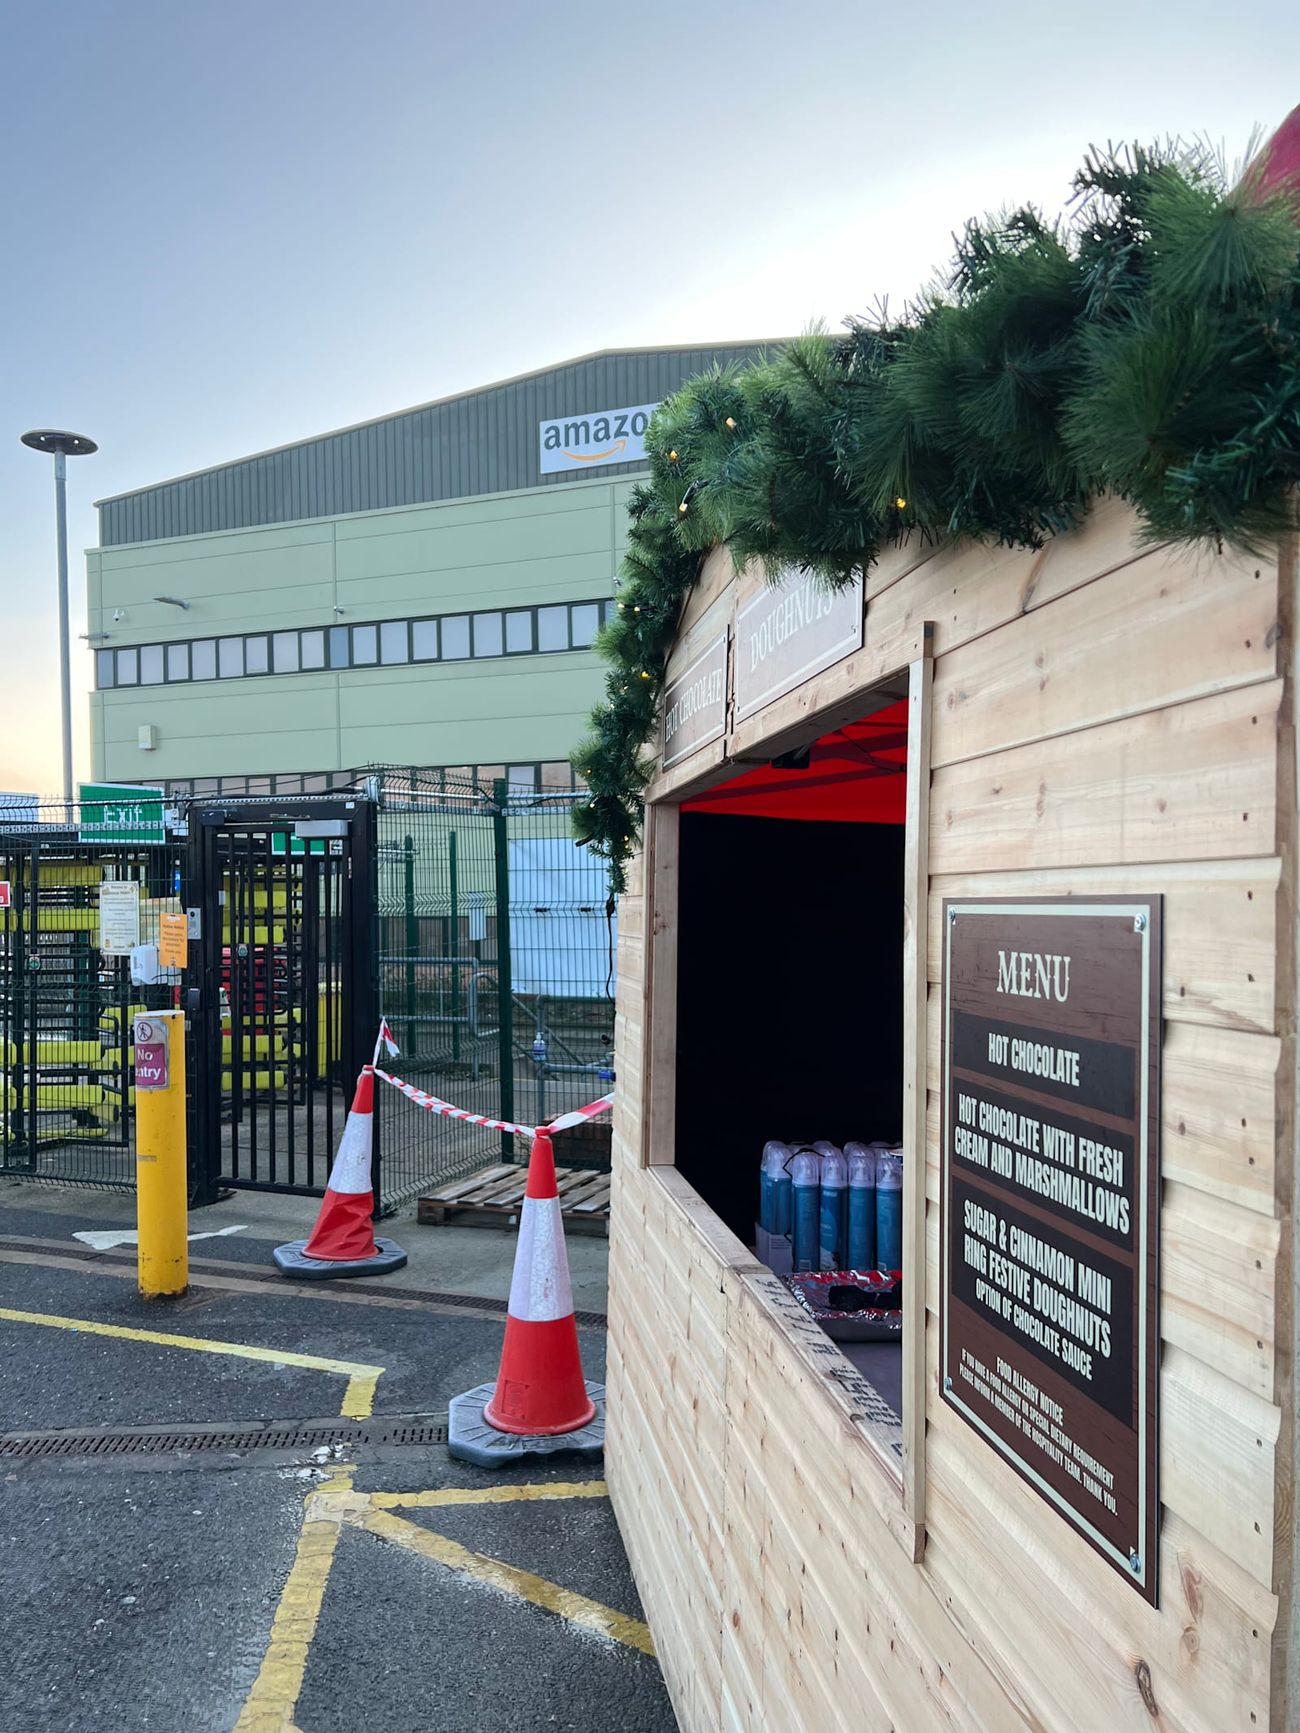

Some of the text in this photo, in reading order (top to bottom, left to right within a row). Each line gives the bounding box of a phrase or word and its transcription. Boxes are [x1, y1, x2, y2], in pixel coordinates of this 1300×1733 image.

[544, 412, 648, 450] amazo
[666, 668, 722, 742] HOT CHOCOLATE
[104, 804, 142, 826] Exit
[997, 951, 1071, 1002] MENU
[138, 1048, 153, 1061] No
[988, 1033, 1080, 1086] HOT CHOCOLATE
[955, 1126, 1130, 1234] CREAM AND MARSHMALLOWS
[958, 1093, 1123, 1188] HOT CHOCOLATE WITH FRESH
[964, 1199, 1112, 1314] SUGAR & CINNAMON MINI
[964, 1234, 1111, 1358] RING FESTIVE DOUGHNUTS
[976, 1278, 1092, 1381] OPTION OF CHOCOLATE SAUCE
[962, 1348, 1114, 1490] IF YOU HAVE A FOOD ALLERGY OR SPECIAL DIETARY REQUIREMENT
[997, 1356, 1063, 1426] FOOD ALLERGY NOTICE
[960, 1362, 1118, 1516] PLEASE INFORM A MEMBER OF THE HOSPITALITY TEAM. THANK YOU.
